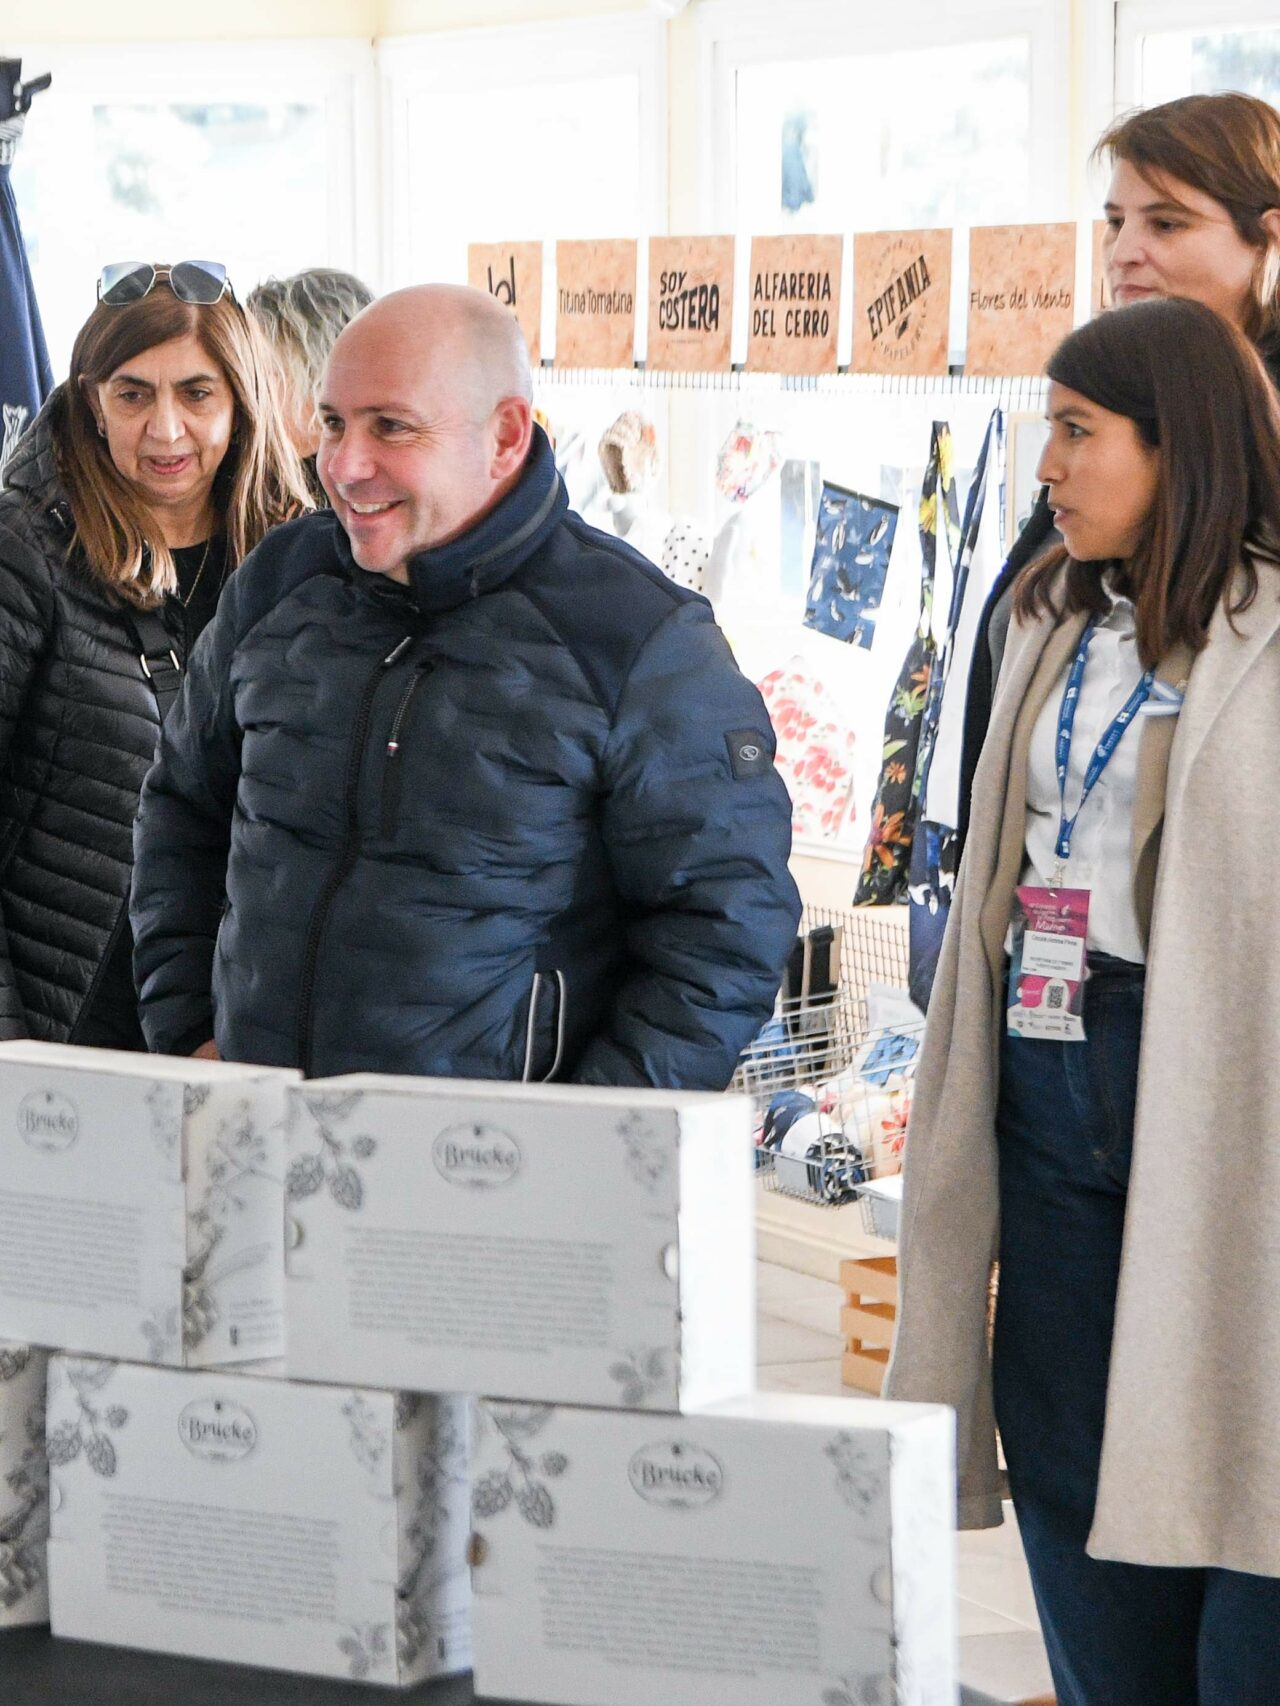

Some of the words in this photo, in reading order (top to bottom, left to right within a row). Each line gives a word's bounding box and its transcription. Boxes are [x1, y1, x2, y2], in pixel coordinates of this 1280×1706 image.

[659, 270, 687, 296] SOY
[753, 271, 832, 302] ALFARERIA
[867, 254, 931, 342] EPIFANIA
[970, 287, 1006, 312] Flores
[1010, 284, 1028, 311] del
[658, 283, 720, 333] COSTERA
[753, 308, 777, 338] DEL
[785, 308, 830, 339] CERRO
